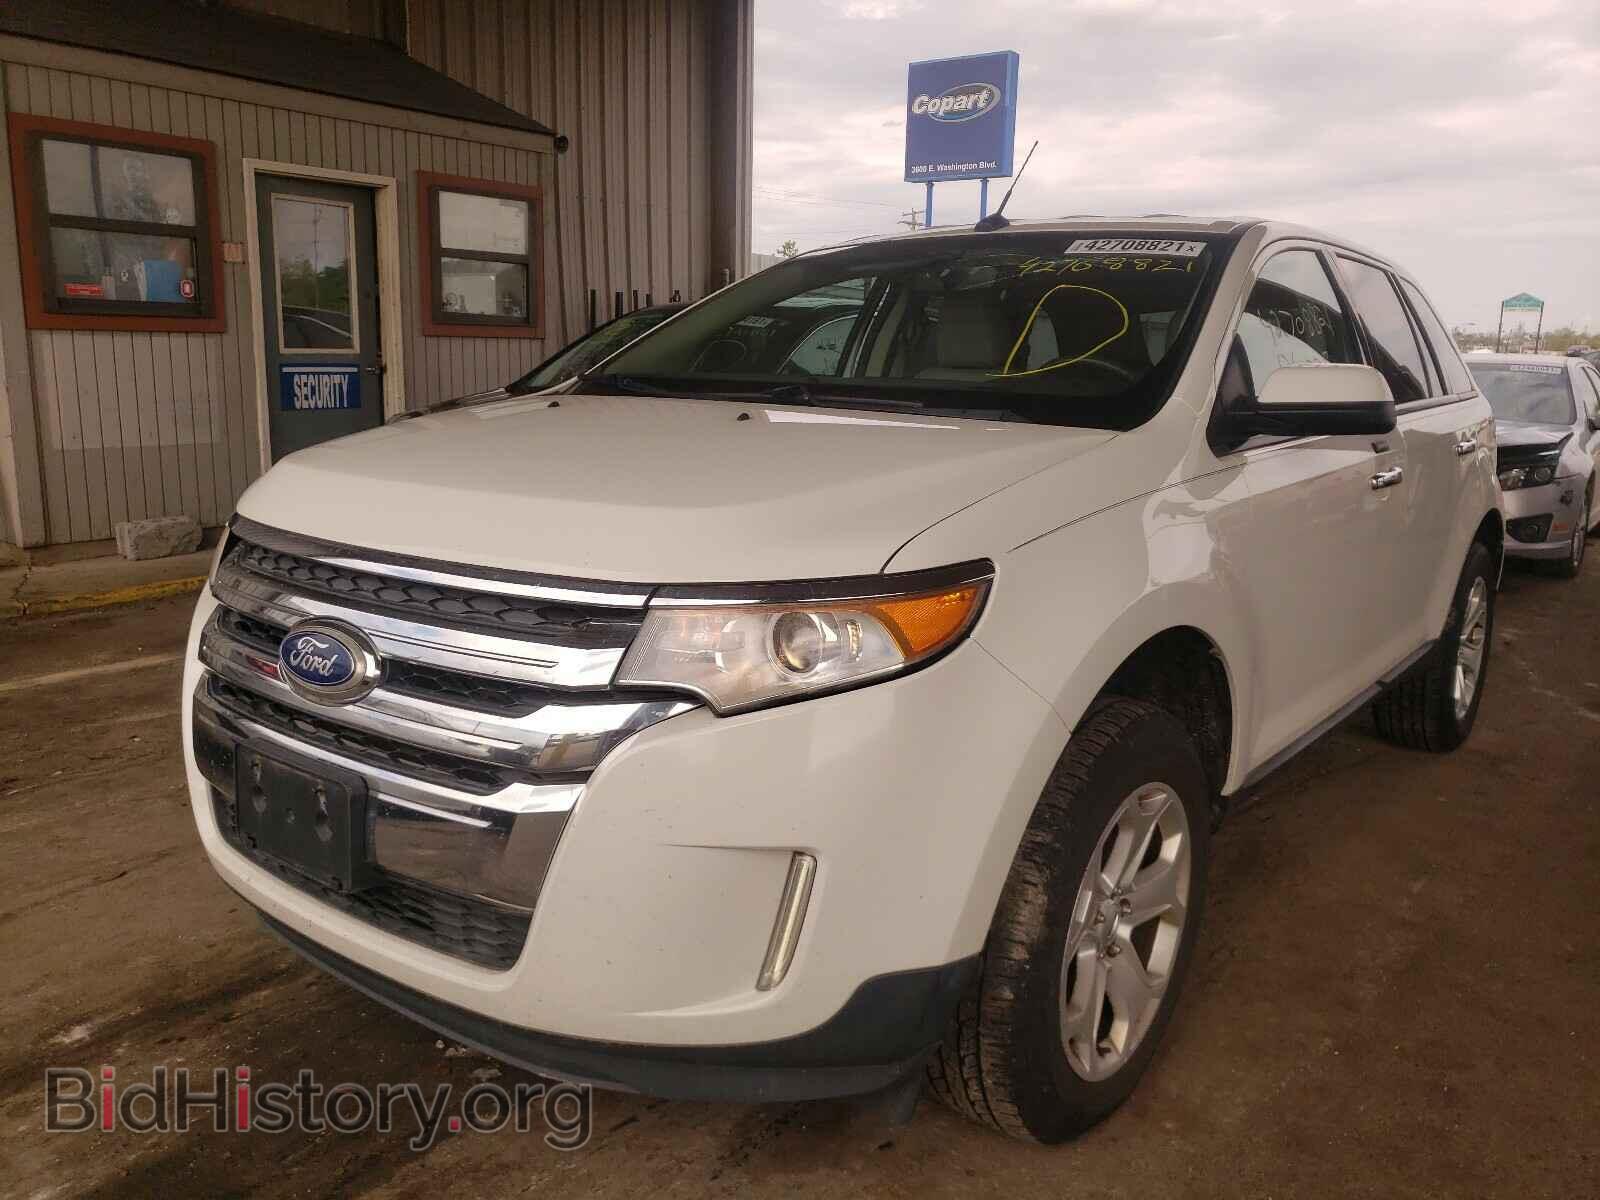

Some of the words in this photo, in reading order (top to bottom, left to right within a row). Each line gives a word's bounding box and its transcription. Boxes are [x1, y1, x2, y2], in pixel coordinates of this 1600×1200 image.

[911, 86, 992, 116] Copart
[937, 161, 978, 172] Washington
[979, 160, 997, 169] Blvd.
[293, 374, 349, 410] SECURITY
[289, 636, 339, 677] Ford
